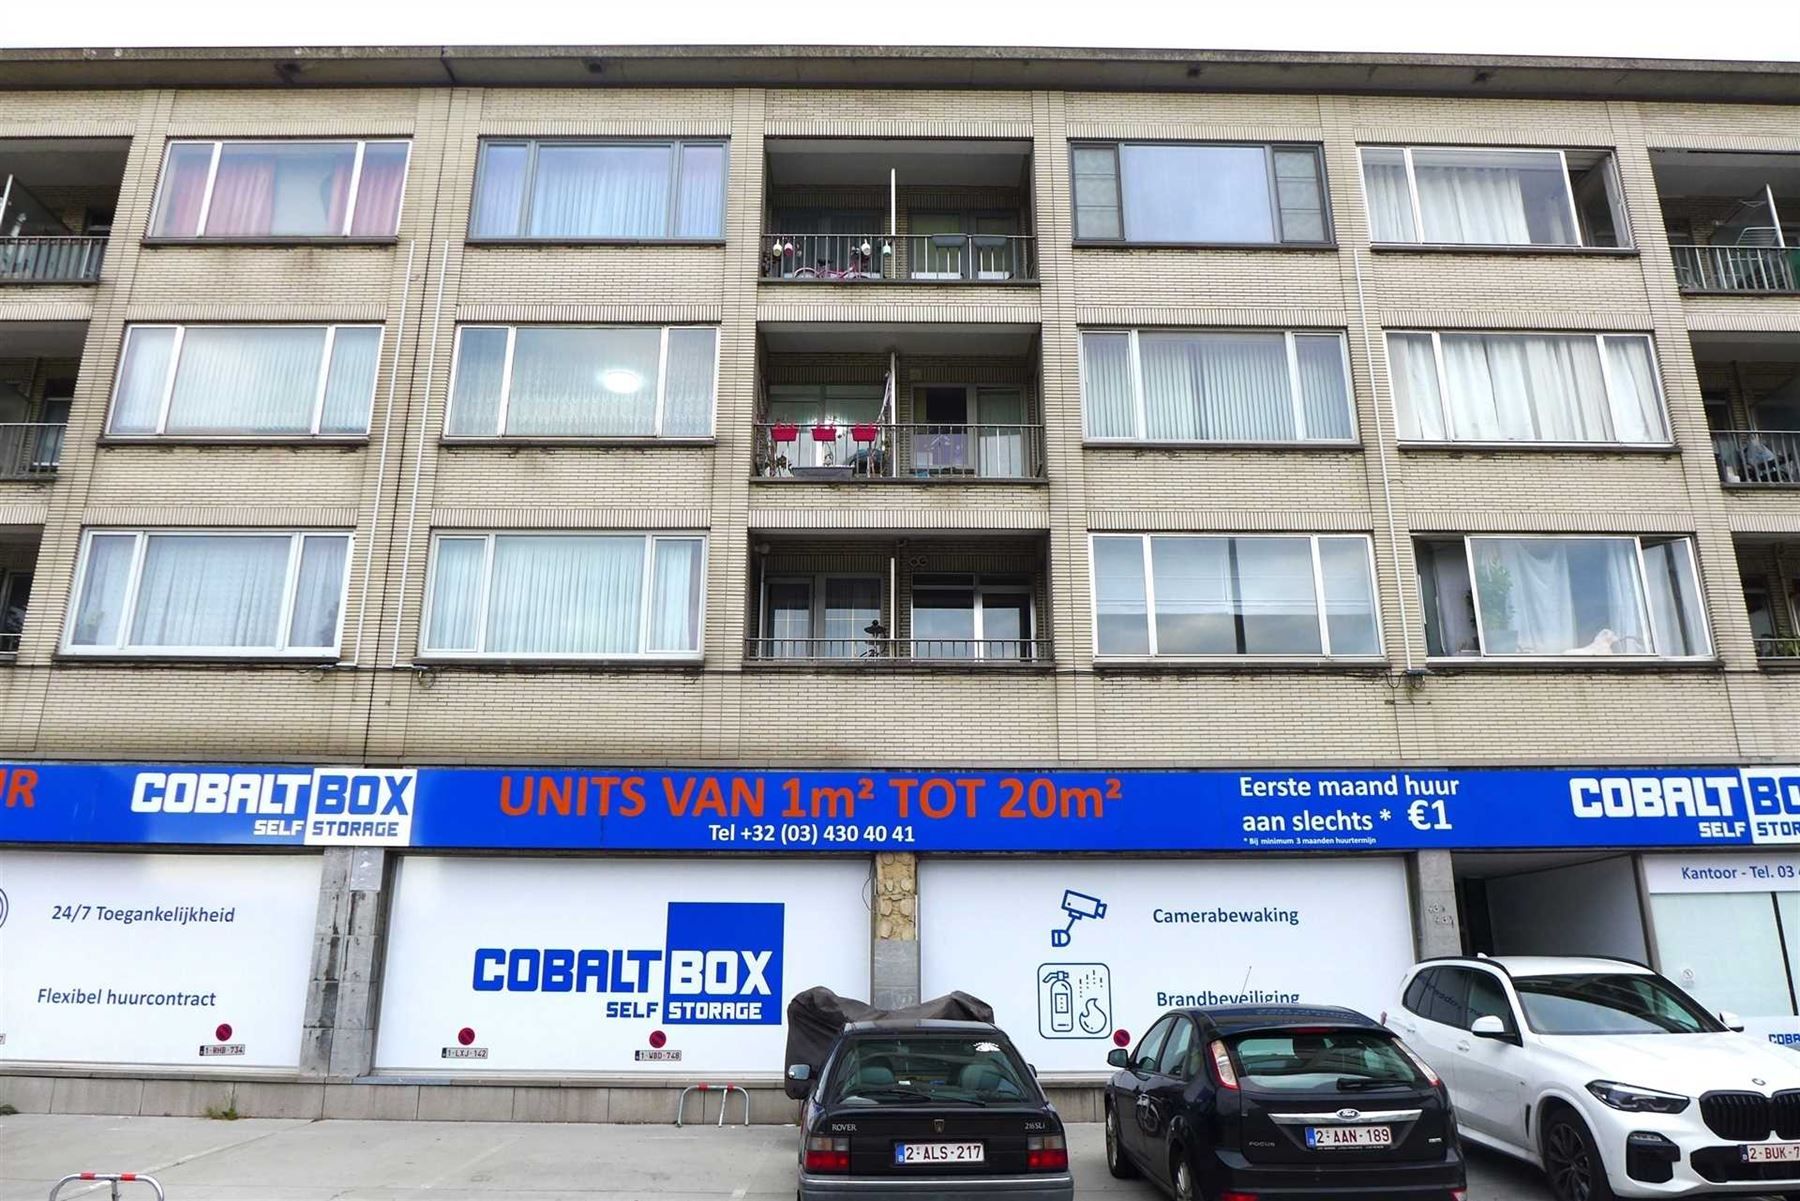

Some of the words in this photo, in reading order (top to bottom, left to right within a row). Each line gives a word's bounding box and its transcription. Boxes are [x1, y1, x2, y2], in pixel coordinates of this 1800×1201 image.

[1239, 776, 1311, 797] Eerste
[1318, 775, 1398, 796] maand
[1404, 775, 1459, 795] huur
[500, 776, 646, 817] UNITS
[662, 777, 765, 817] VAN
[782, 777, 875, 818] 1m²
[889, 778, 995, 819] TOT
[999, 778, 1122, 819] 20m²
[1242, 815, 1286, 832] aan
[1292, 810, 1373, 832] slechts
[1407, 799, 1452, 830] €1
[253, 820, 305, 836] SELF
[312, 821, 398, 837] STORAGE
[708, 825, 735, 841] Tel
[740, 825, 775, 841] +32
[780, 824, 818, 845] (03)
[823, 825, 859, 842] 430
[863, 826, 887, 842] 40
[891, 826, 915, 842] 41
[1698, 821, 1746, 838] SELF
[1249, 837, 1259, 845] Bij
[1682, 867, 1737, 880] Kantoor
[1749, 866, 1774, 878] Tel.
[1777, 866, 1794, 878] 03
[52, 904, 91, 923] 24/7
[97, 905, 235, 925] Toegankelijkheid
[1153, 907, 1299, 926] Camerabewaking
[37, 987, 102, 1005] Flexibel
[107, 989, 216, 1007] huurcontract
[1156, 990, 1300, 1007] Brandbeveiliging
[606, 1002, 658, 1018] SELF
[668, 1002, 762, 1020] STORAGE
[831, 1123, 857, 1132] ROVER
[1315, 1129, 1390, 1144] 2-AAN-189
[905, 1145, 982, 1161] 2-ALS-217
